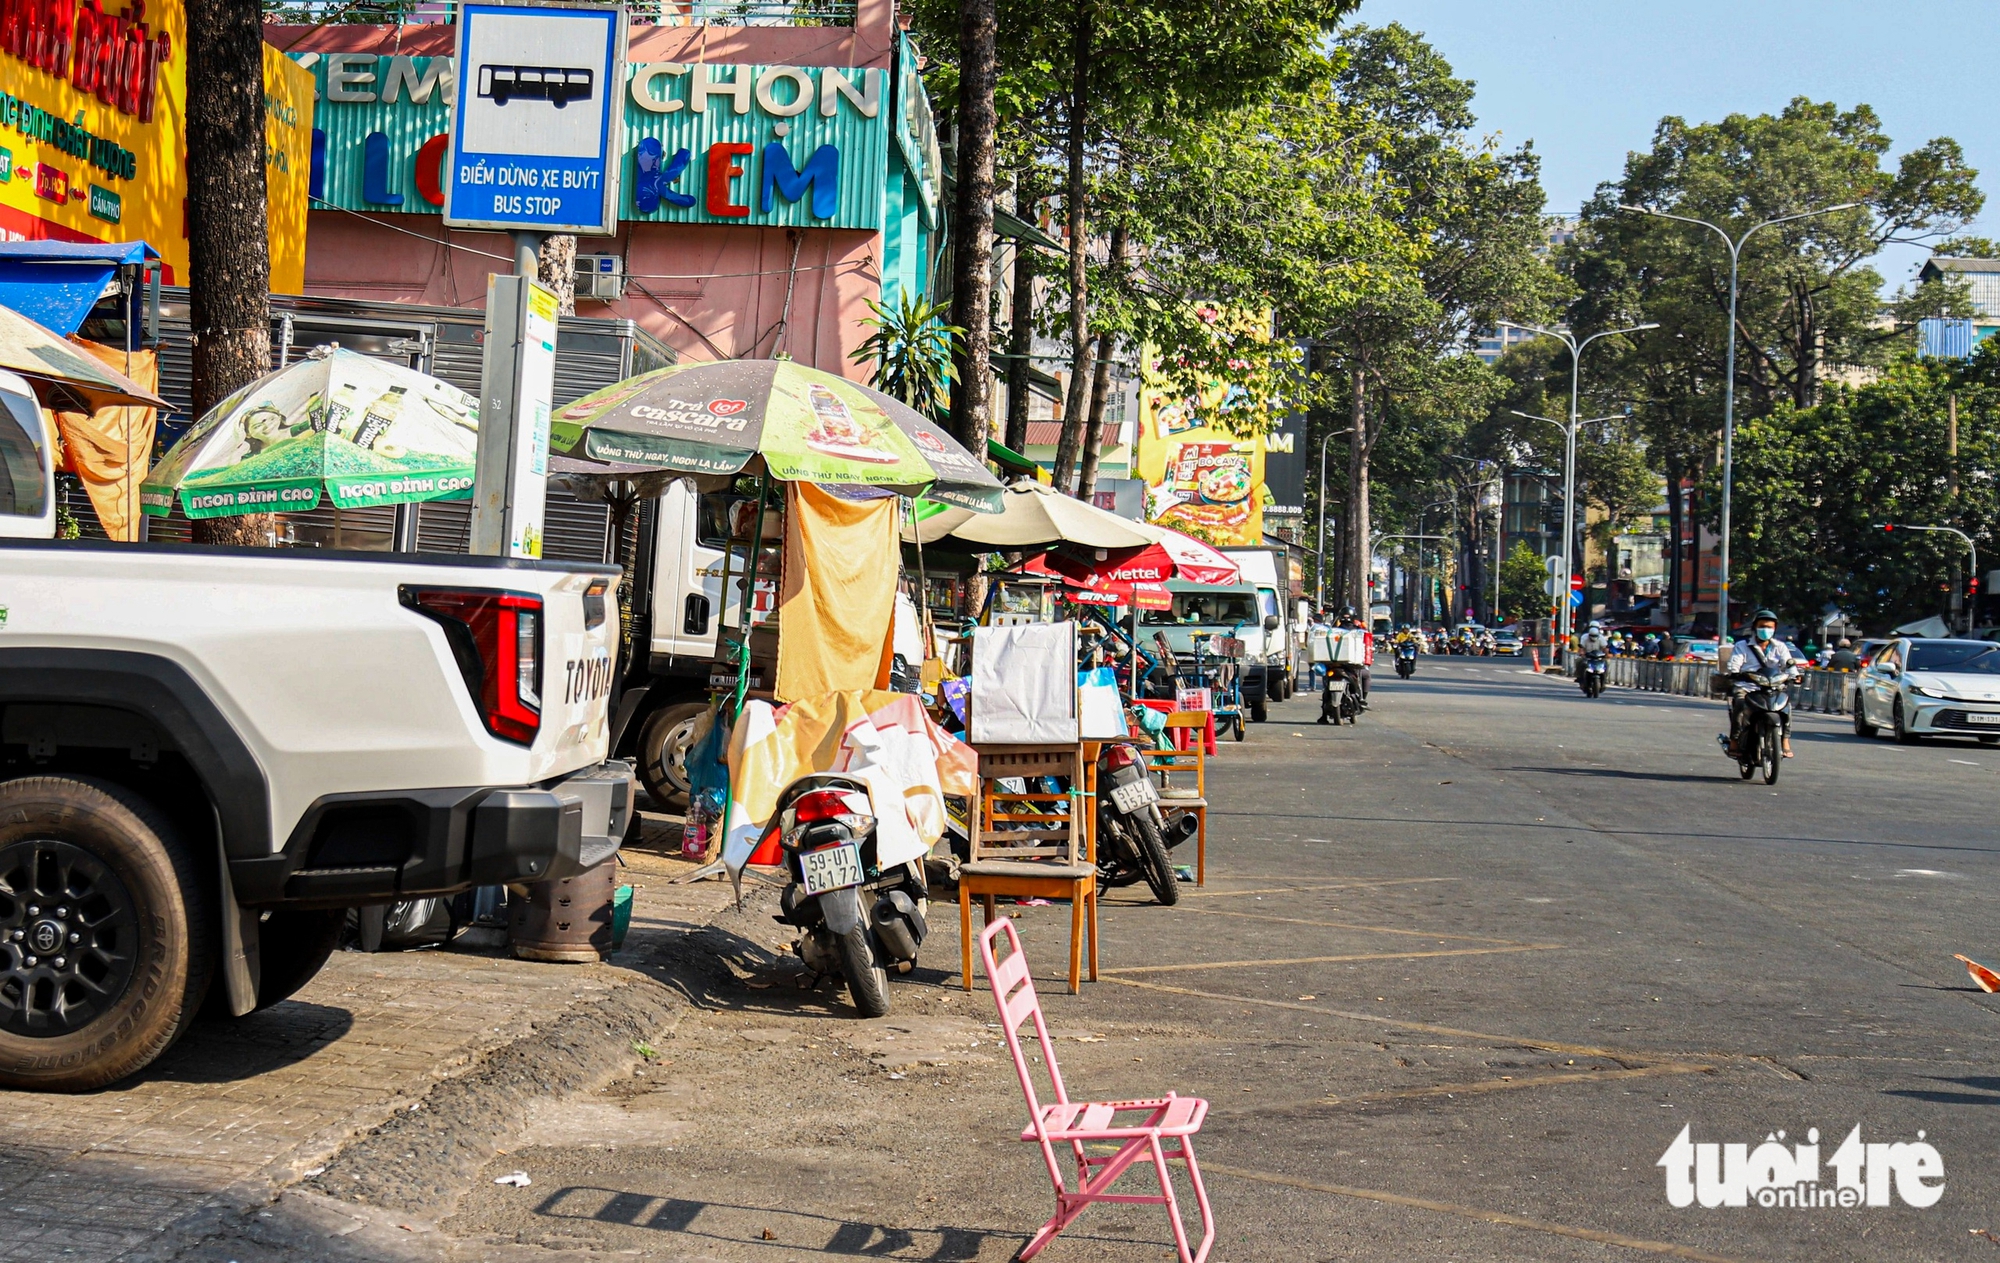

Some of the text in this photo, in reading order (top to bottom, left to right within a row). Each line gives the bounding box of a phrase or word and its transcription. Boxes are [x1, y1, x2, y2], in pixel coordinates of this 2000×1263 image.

[631, 62, 880, 137] CHỌN
[460, 158, 600, 190] ĐIỂM DỪNG XE BUÝT
[636, 137, 840, 219] KEM
[494, 195, 562, 216] BUS STOP
[492, 398, 502, 410] 32
[668, 399, 703, 411] Trà
[644, 452, 669, 463] NGAY,
[671, 455, 697, 466] NGON
[699, 459, 710, 470] LẠ
[1200, 456, 1237, 465] BÒ CAY
[390, 475, 434, 494] ĐỈNH
[437, 477, 474, 492] CAO
[192, 487, 314, 509] NGON ĐỈNH CAO
[1107, 567, 1161, 581] viettel
[1077, 591, 1119, 603] STING
[564, 656, 612, 705] TOYOTA
[1117, 781, 1146, 800] 51-L7
[809, 847, 850, 873] 59-U1
[808, 866, 858, 893] 641.72
